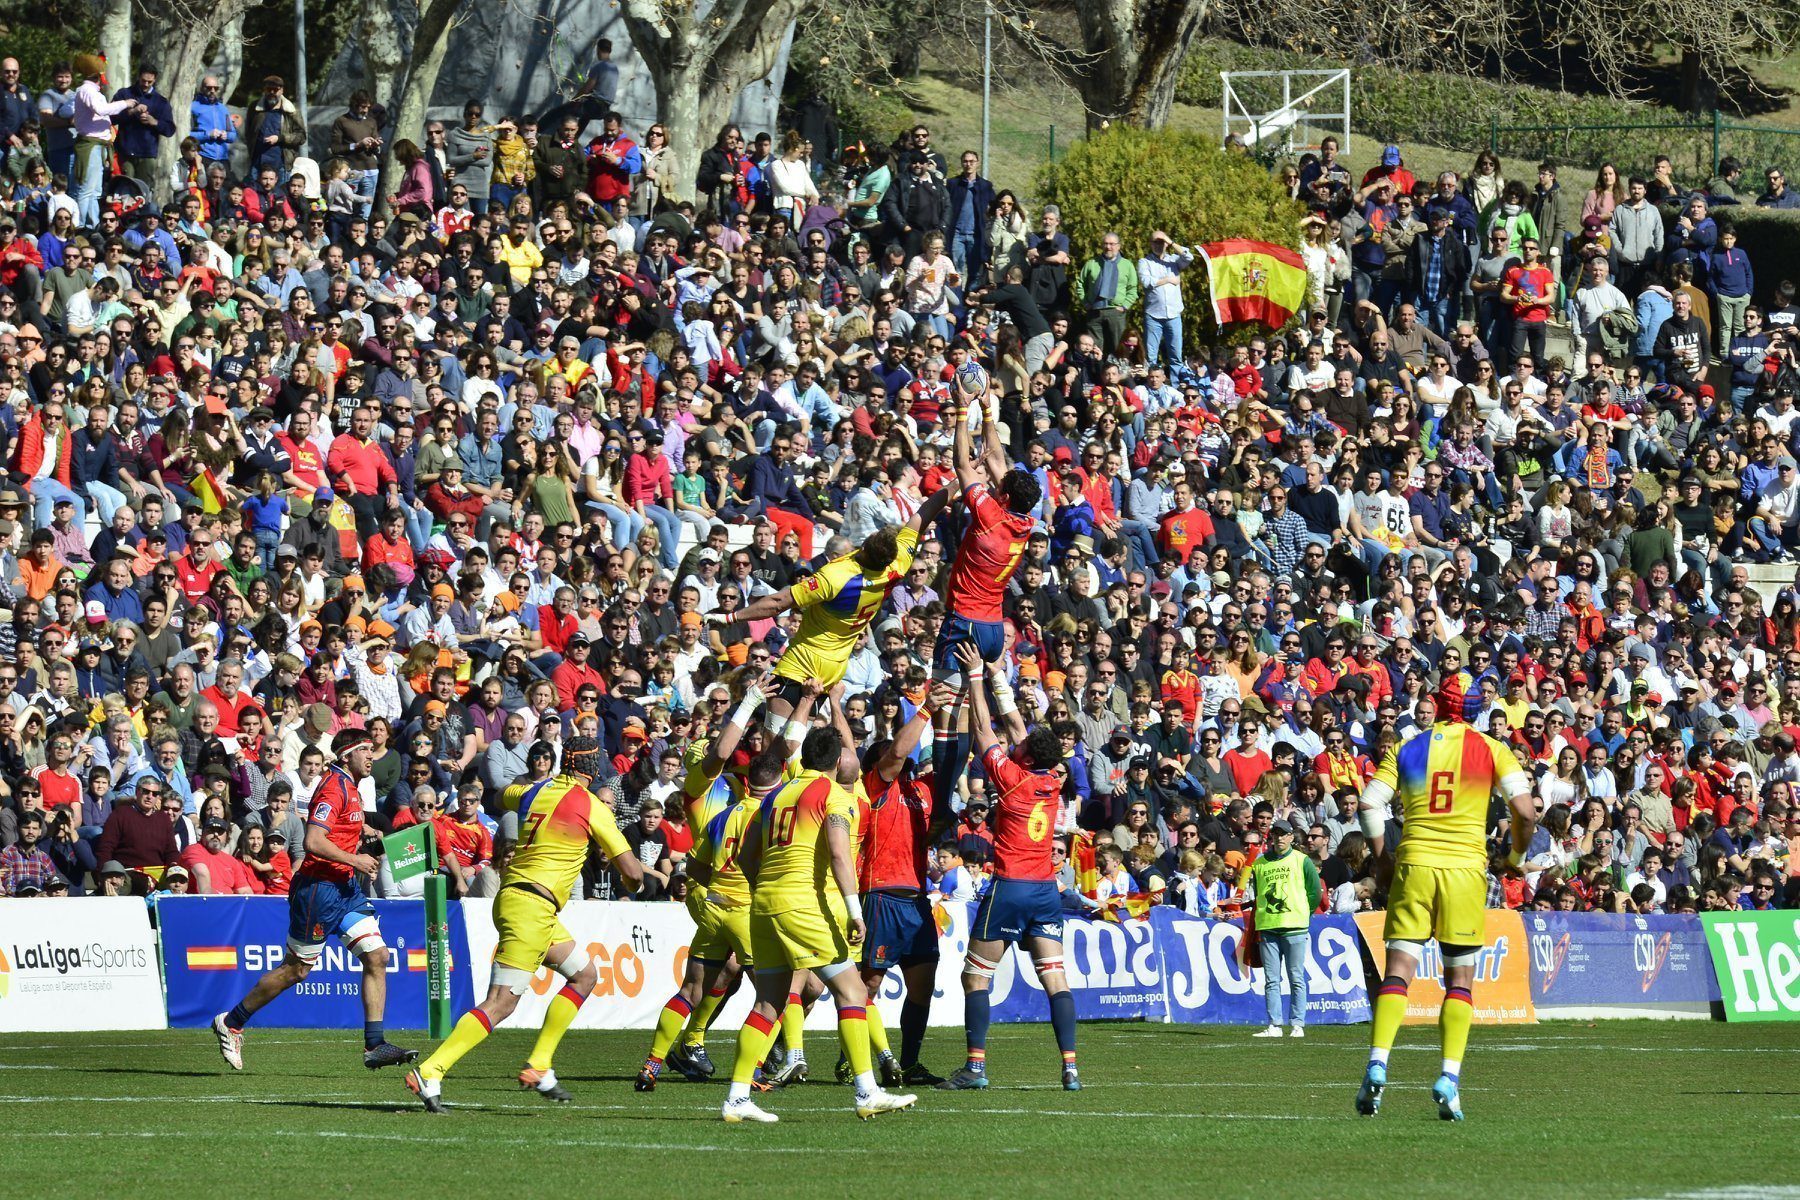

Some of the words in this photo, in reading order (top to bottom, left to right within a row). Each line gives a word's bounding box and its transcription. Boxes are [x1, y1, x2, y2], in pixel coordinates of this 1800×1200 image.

[1429, 771, 1454, 813] 6
[523, 813, 548, 850] 7
[768, 805, 798, 848] 10
[1027, 800, 1049, 842] 6
[720, 837, 740, 872] 2
[1265, 874, 1289, 882] RUGBY
[13, 940, 147, 974] LaLiga4Sports
[632, 925, 654, 953] fit
[1532, 934, 1555, 972] CSD
[1634, 933, 1656, 971] CSD
[429, 939, 440, 1000] Heineken
[296, 983, 331, 995] DESDE
[336, 983, 359, 996] 1933
